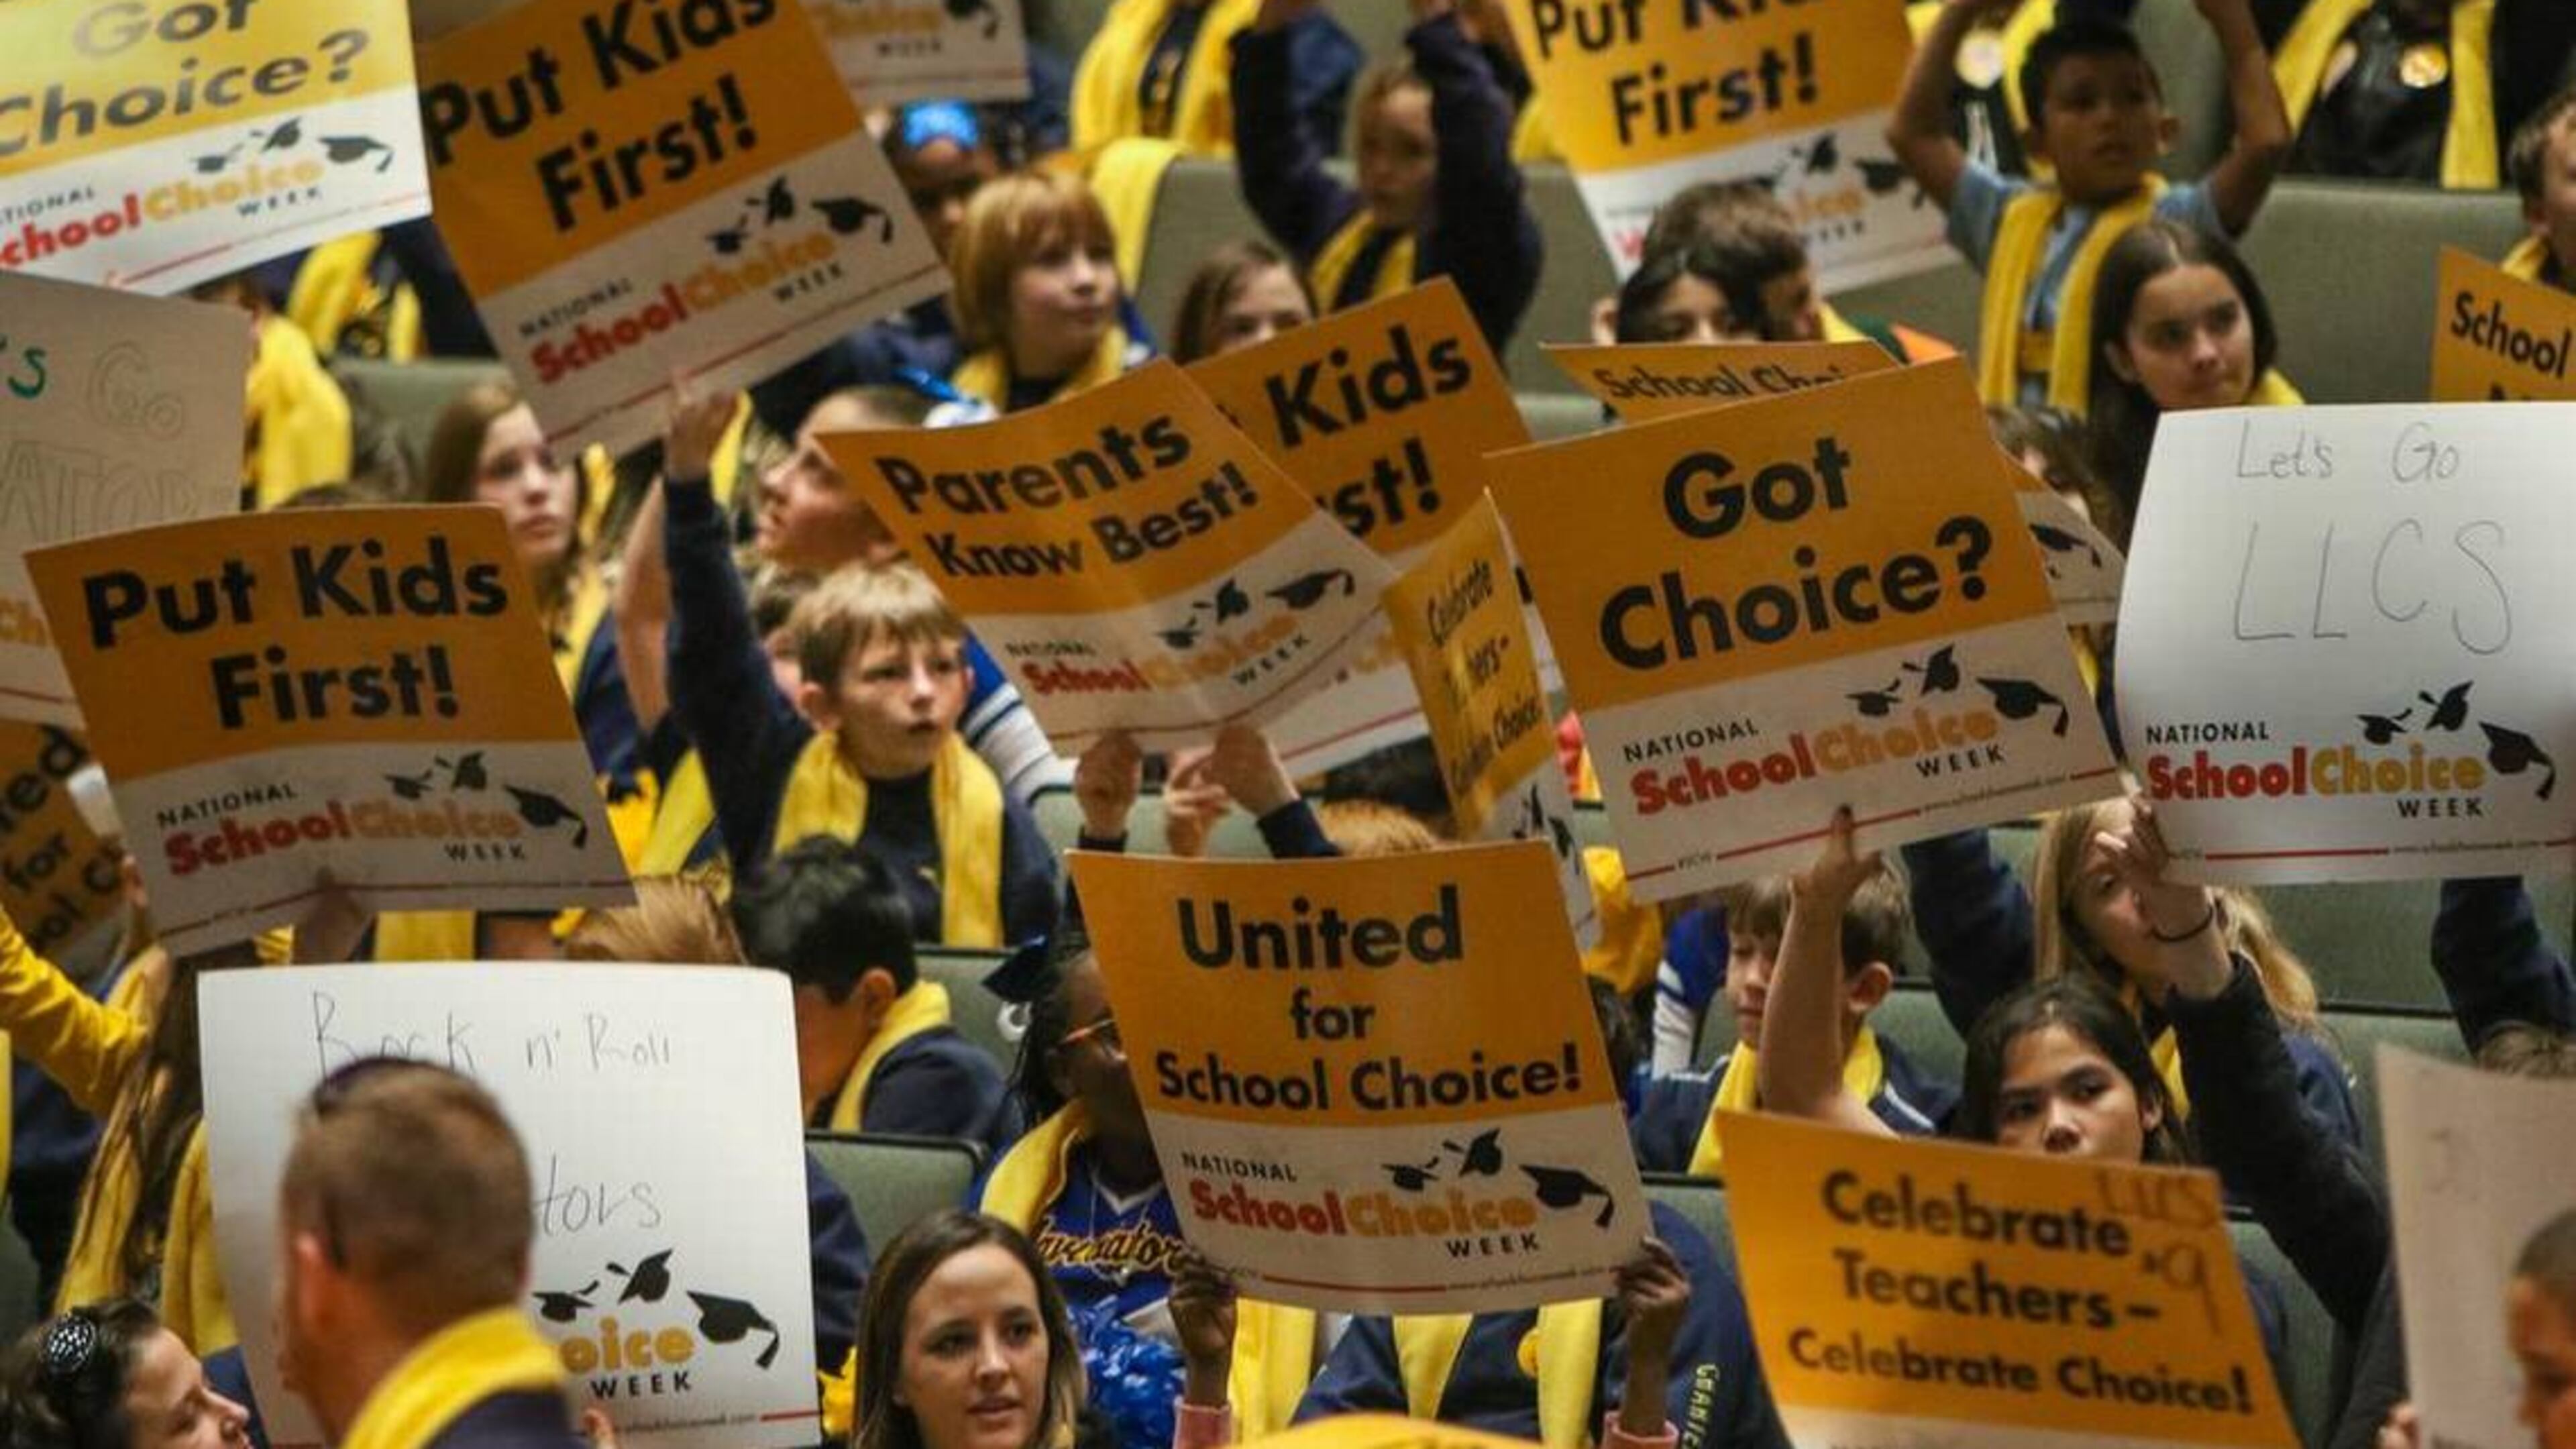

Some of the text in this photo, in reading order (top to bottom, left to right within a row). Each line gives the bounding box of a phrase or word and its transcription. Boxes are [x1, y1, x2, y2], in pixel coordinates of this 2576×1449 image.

[72, 0, 263, 56] Got
[419, 47, 562, 167] Put
[1611, 34, 1819, 146] First!
[537, 72, 758, 233] First!
[519, 275, 634, 337] NATIONAL
[773, 263, 844, 303] WEEK
[2451, 290, 2573, 380] School
[1266, 323, 1472, 448] Kids
[1594, 364, 1752, 398] School
[873, 413, 1194, 515] Parents
[2392, 421, 2461, 484] Go
[924, 460, 1260, 578] Know Best!
[1664, 437, 1850, 538] Got
[82, 555, 256, 649] Put
[292, 537, 508, 619] Kids
[1599, 517, 1992, 669] Choice?
[2235, 518, 2512, 655] LLCS
[211, 645, 460, 729] First!
[1233, 634, 1308, 686] WEEK
[1625, 719, 1759, 762] NATIONAL
[1916, 745, 2006, 778] WEEK
[2147, 721, 2270, 743] NATIONAL
[157, 785, 298, 828] NATIONAL
[2397, 798, 2485, 819] WEEK
[445, 844, 527, 861] WEEK
[1177, 884, 1464, 971] United
[1291, 989, 1375, 1040] for
[1155, 1042, 1581, 1110] School Choice!
[1182, 1152, 1297, 1183] NATIONAL
[1446, 1233, 1541, 1259] WEEK
[1820, 1170, 2132, 1258] Celebrate
[590, 1372, 692, 1399] WEEK
[1786, 1327, 2255, 1415] Celebrate Choice!
